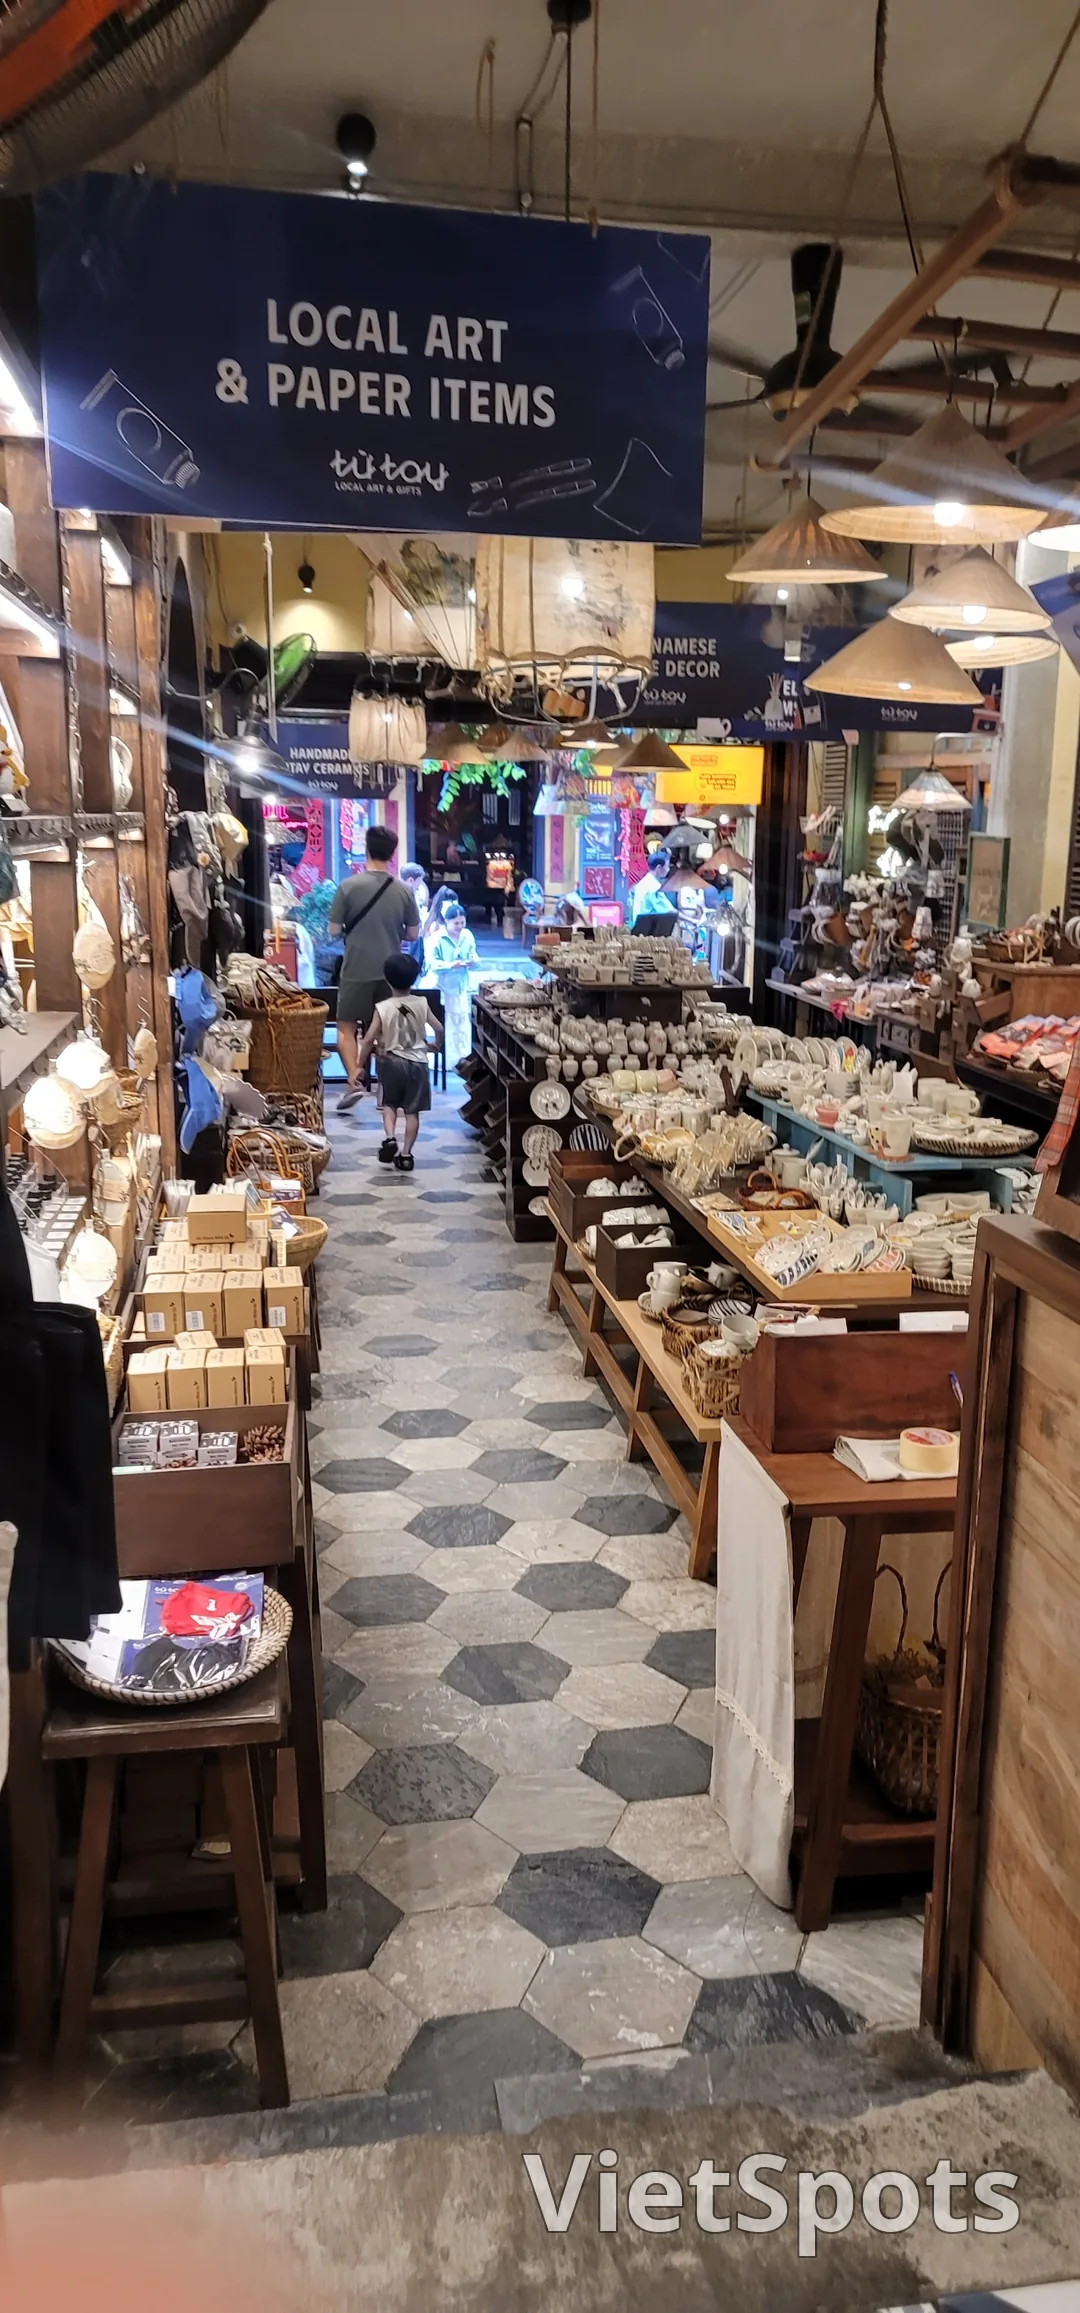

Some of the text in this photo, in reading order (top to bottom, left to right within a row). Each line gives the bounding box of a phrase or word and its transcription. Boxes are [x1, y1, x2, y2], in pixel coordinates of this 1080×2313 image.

[266, 298, 510, 363] LOCAL ART
[215, 357, 557, 429] & PAPER ITEMS
[334, 481, 423, 496] LOCAL ART & GIFTS
[652, 637, 717, 655] NAMESE
[665, 660, 721, 678] DECOR
[289, 746, 351, 761] HANDMAD
[314, 762, 370, 776] CERAMS
